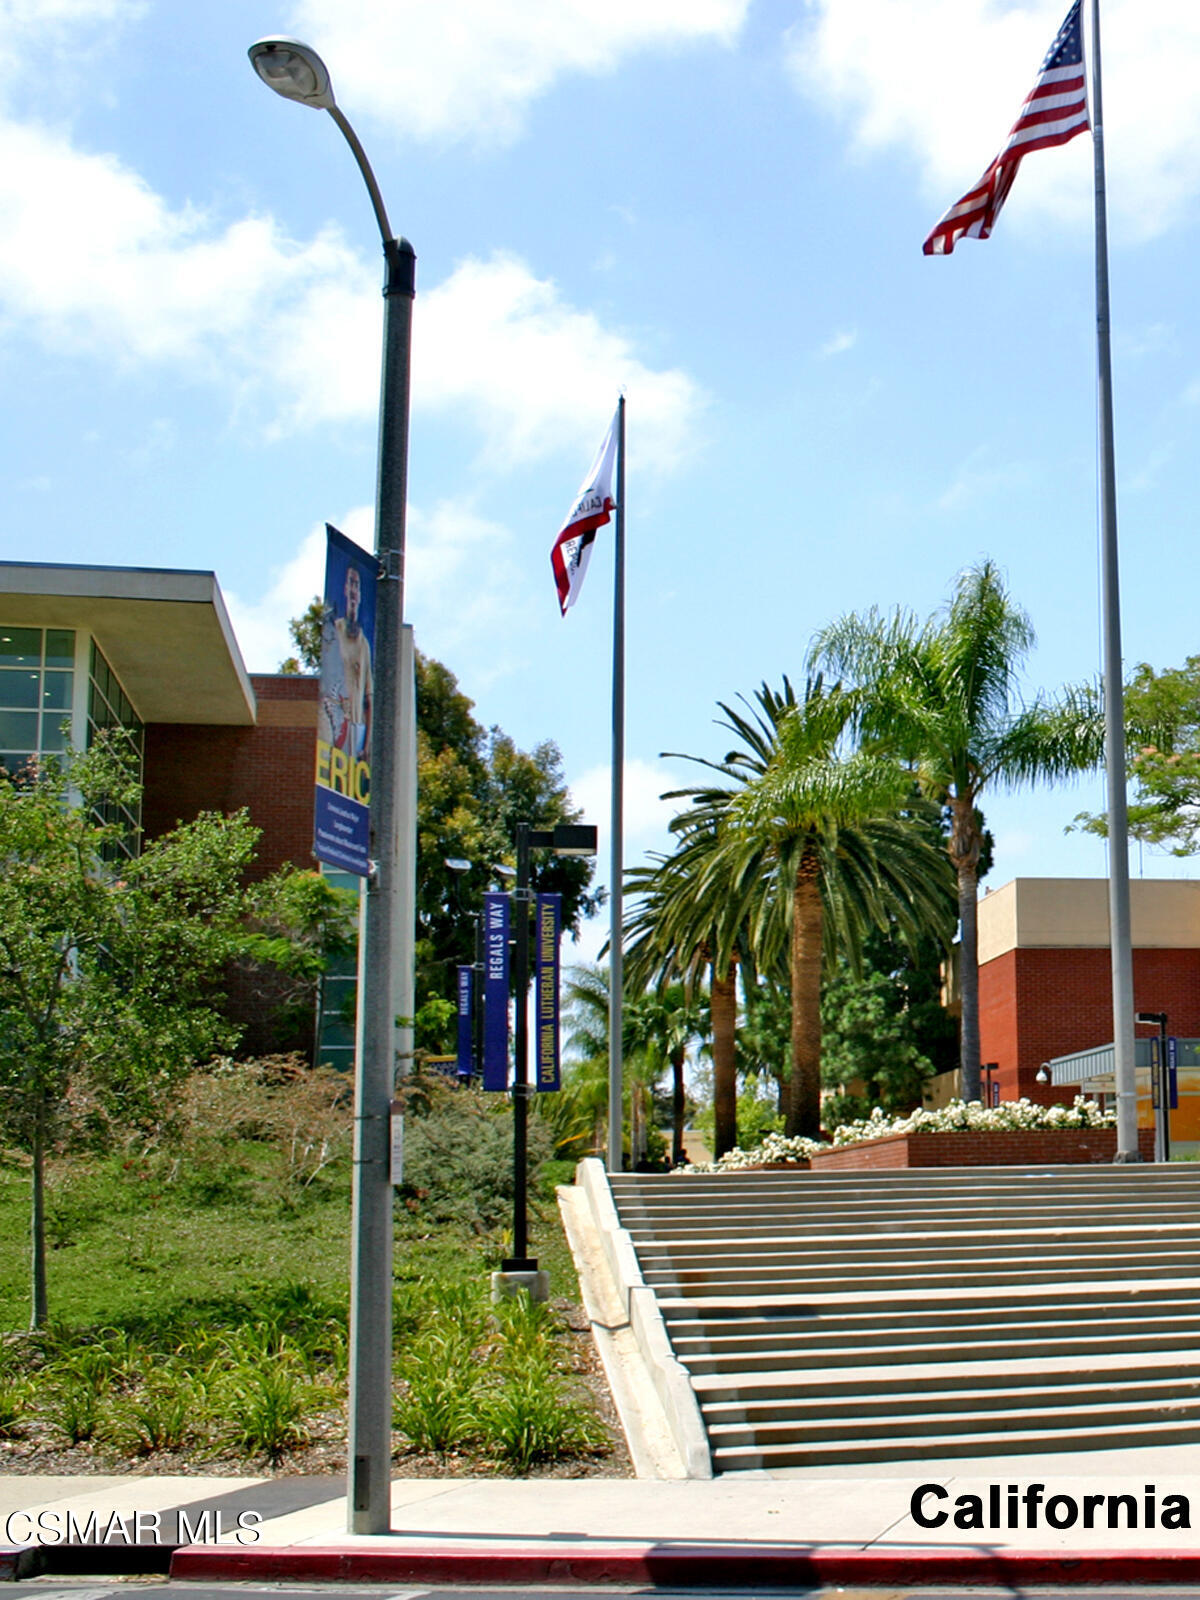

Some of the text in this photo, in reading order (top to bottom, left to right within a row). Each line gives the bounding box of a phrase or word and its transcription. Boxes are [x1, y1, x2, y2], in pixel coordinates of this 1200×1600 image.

[316, 738, 371, 806] ERIC
[489, 902, 504, 980] REGALS WAY
[541, 903, 555, 1084] CALIFORNIA LUTHERAN UNIVERSITY
